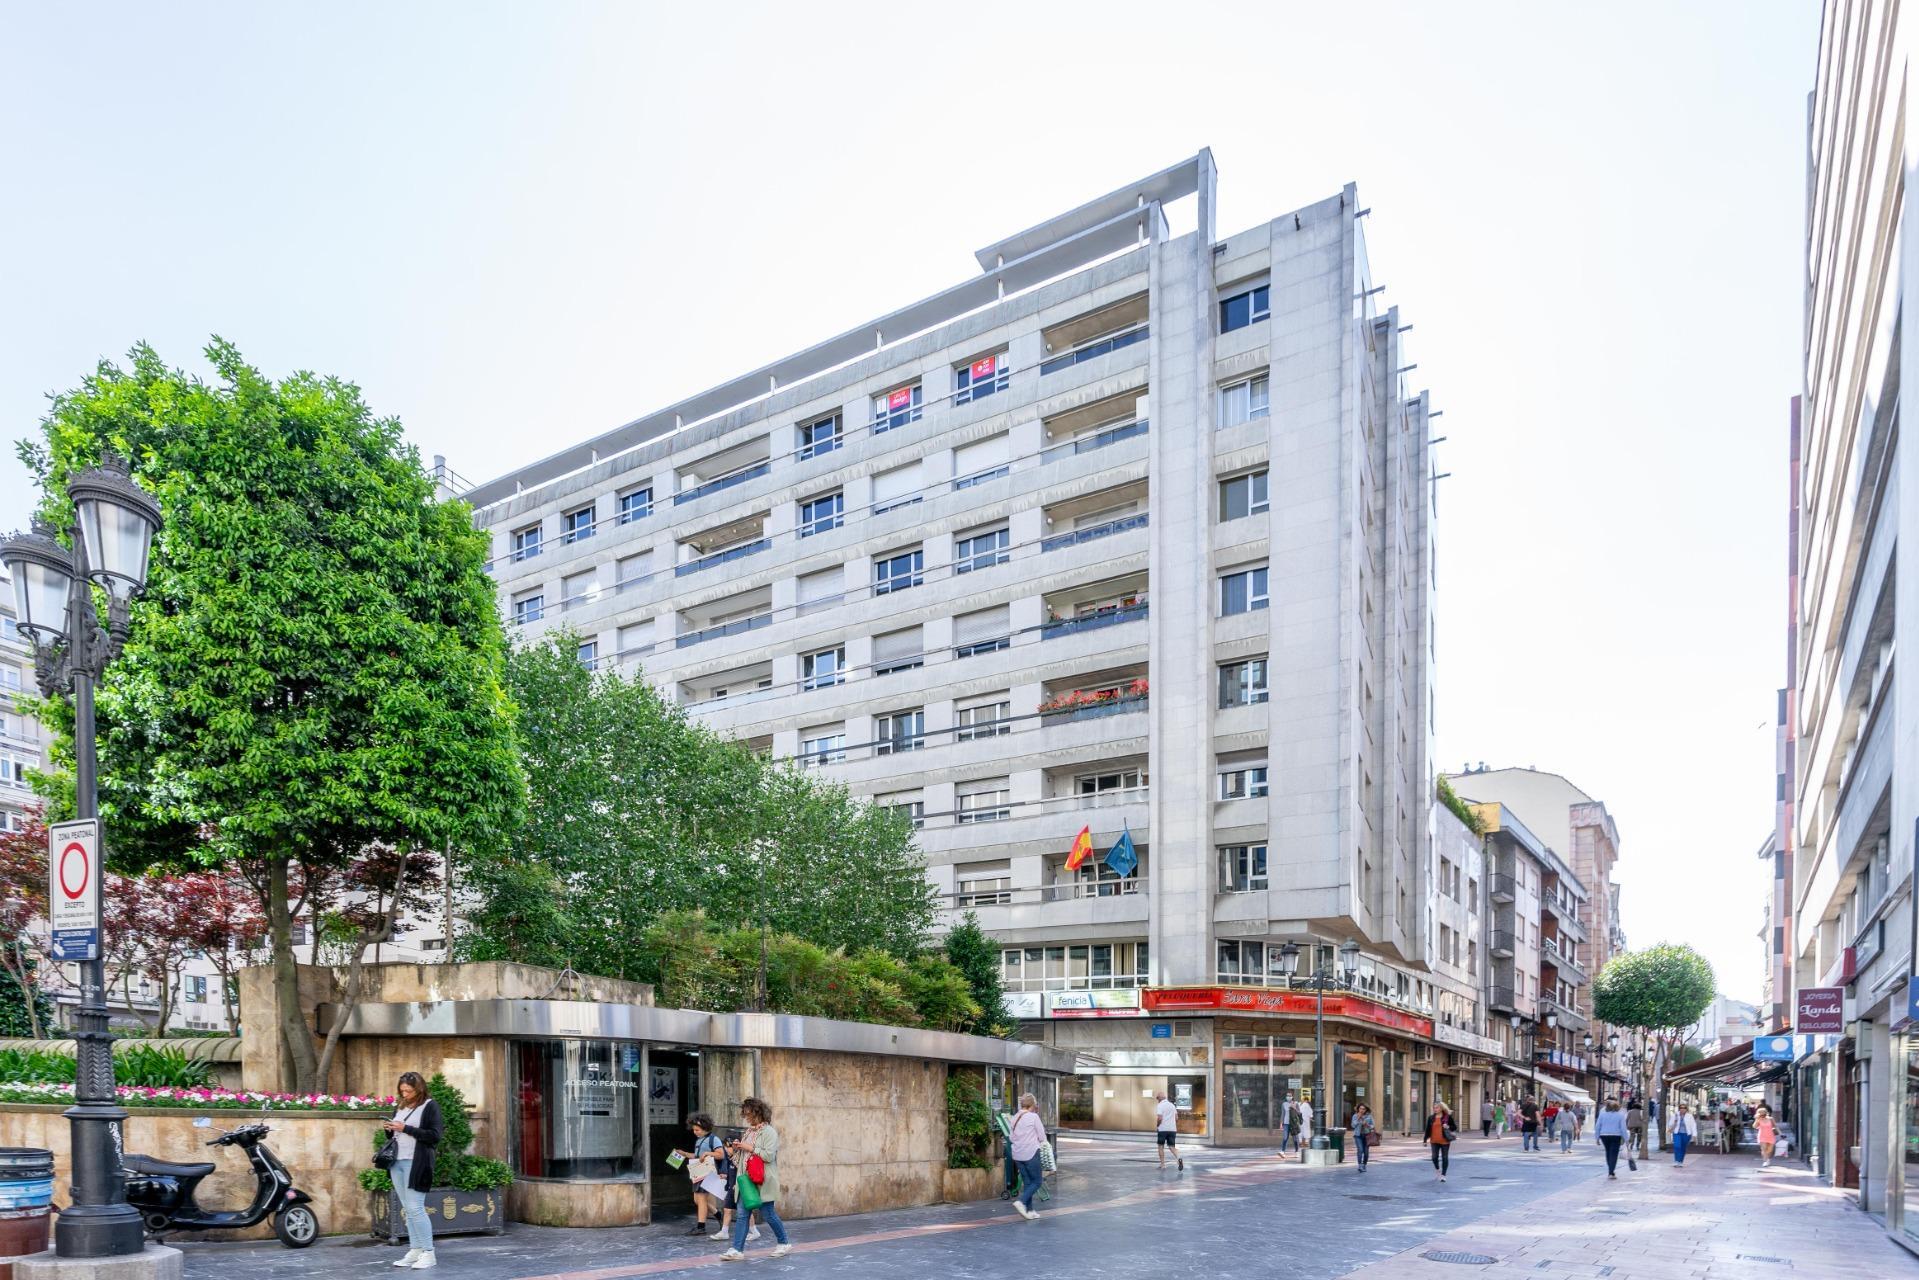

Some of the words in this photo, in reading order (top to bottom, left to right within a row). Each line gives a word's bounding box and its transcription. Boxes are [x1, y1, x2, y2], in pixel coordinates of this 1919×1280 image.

[1058, 995, 1087, 1006] fenicia
[1223, 990, 1252, 1004] Sara
[1257, 993, 1284, 1010] Vega
[1799, 1003, 1841, 1018] Landa
[564, 1079, 598, 1087] ACCESO
[599, 1080, 638, 1088] PEATONAL
